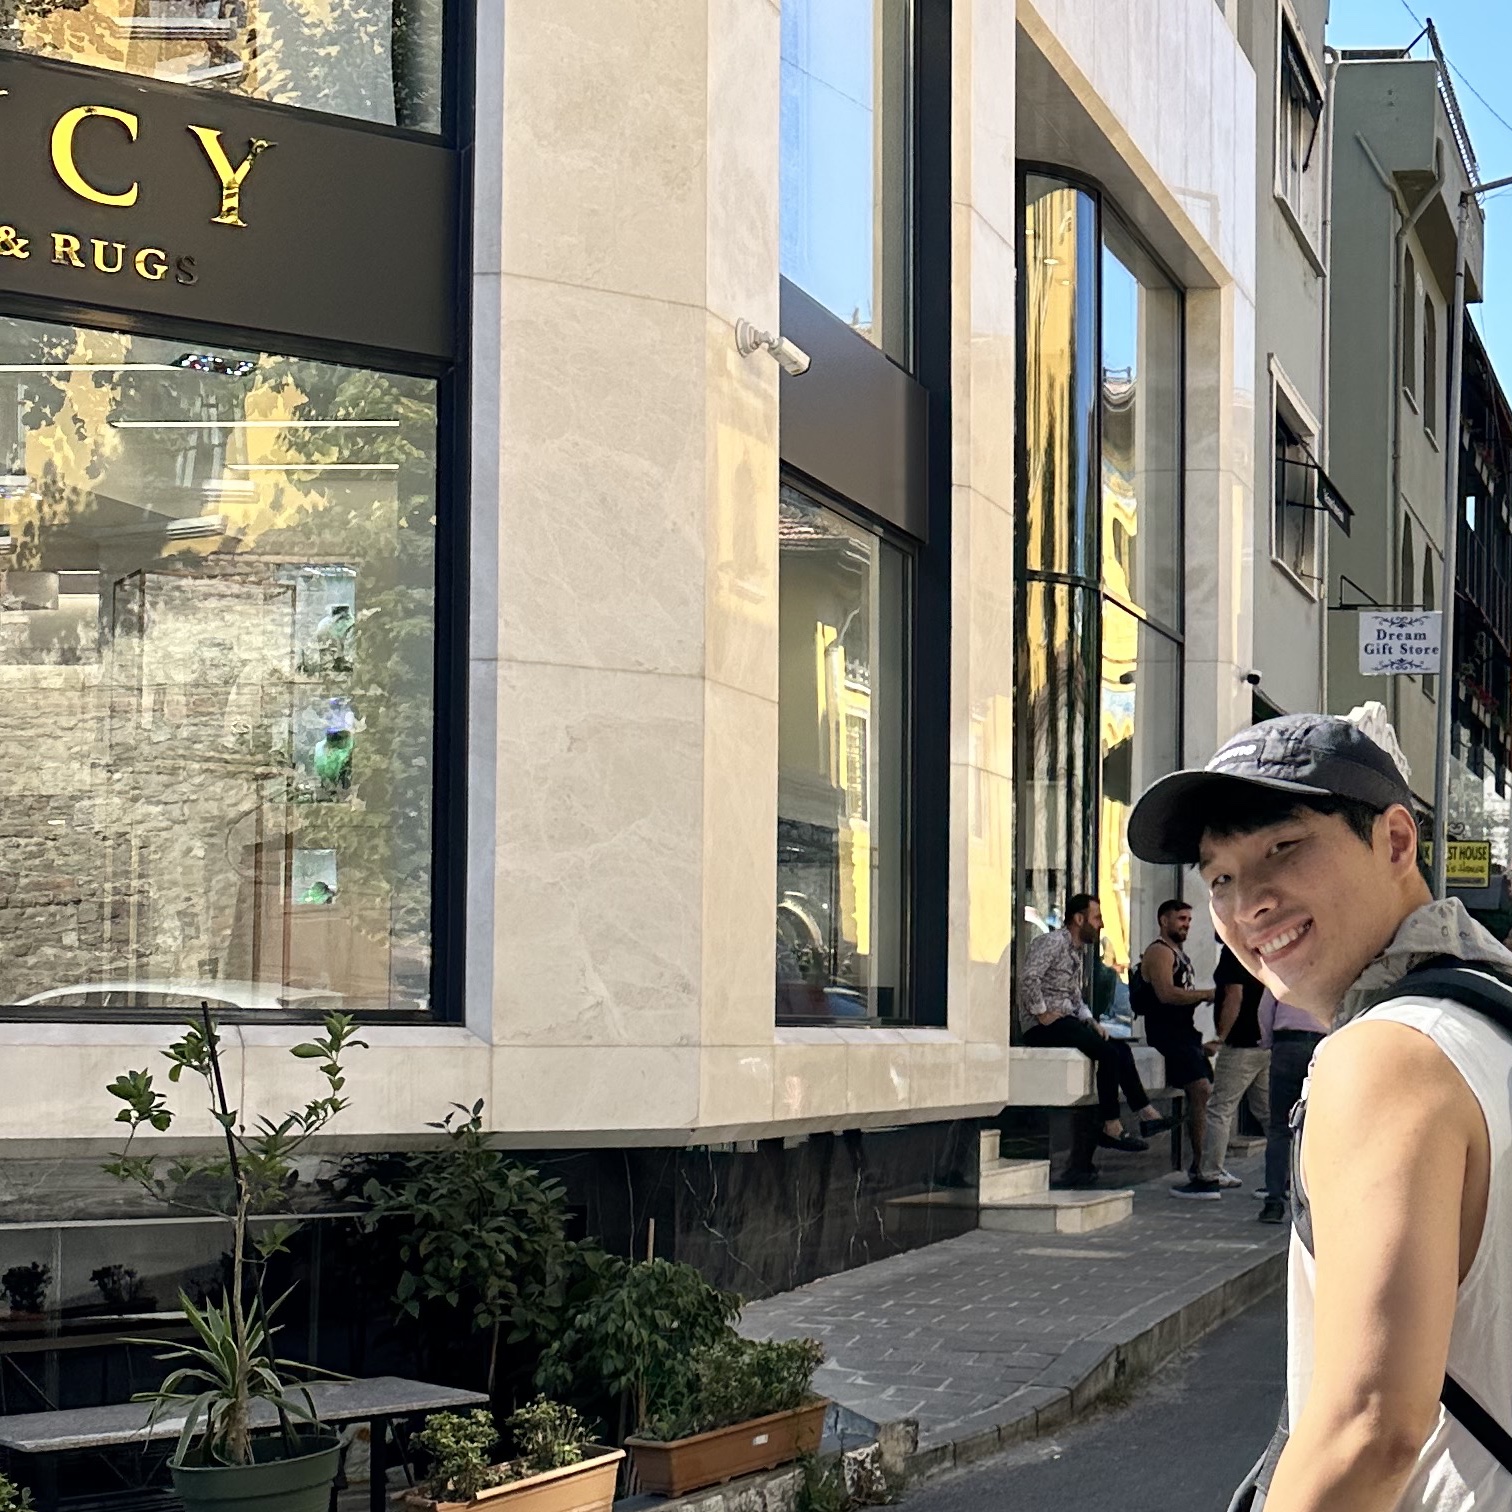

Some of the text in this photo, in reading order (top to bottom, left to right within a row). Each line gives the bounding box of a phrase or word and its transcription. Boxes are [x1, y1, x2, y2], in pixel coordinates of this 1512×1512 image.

[0, 90, 278, 228] CY
[0, 225, 199, 286] & RUGS
[1376, 628, 1427, 641] Dream
[1364, 642, 1440, 655] Gift Store
[1459, 845, 1488, 860] HOUSE
